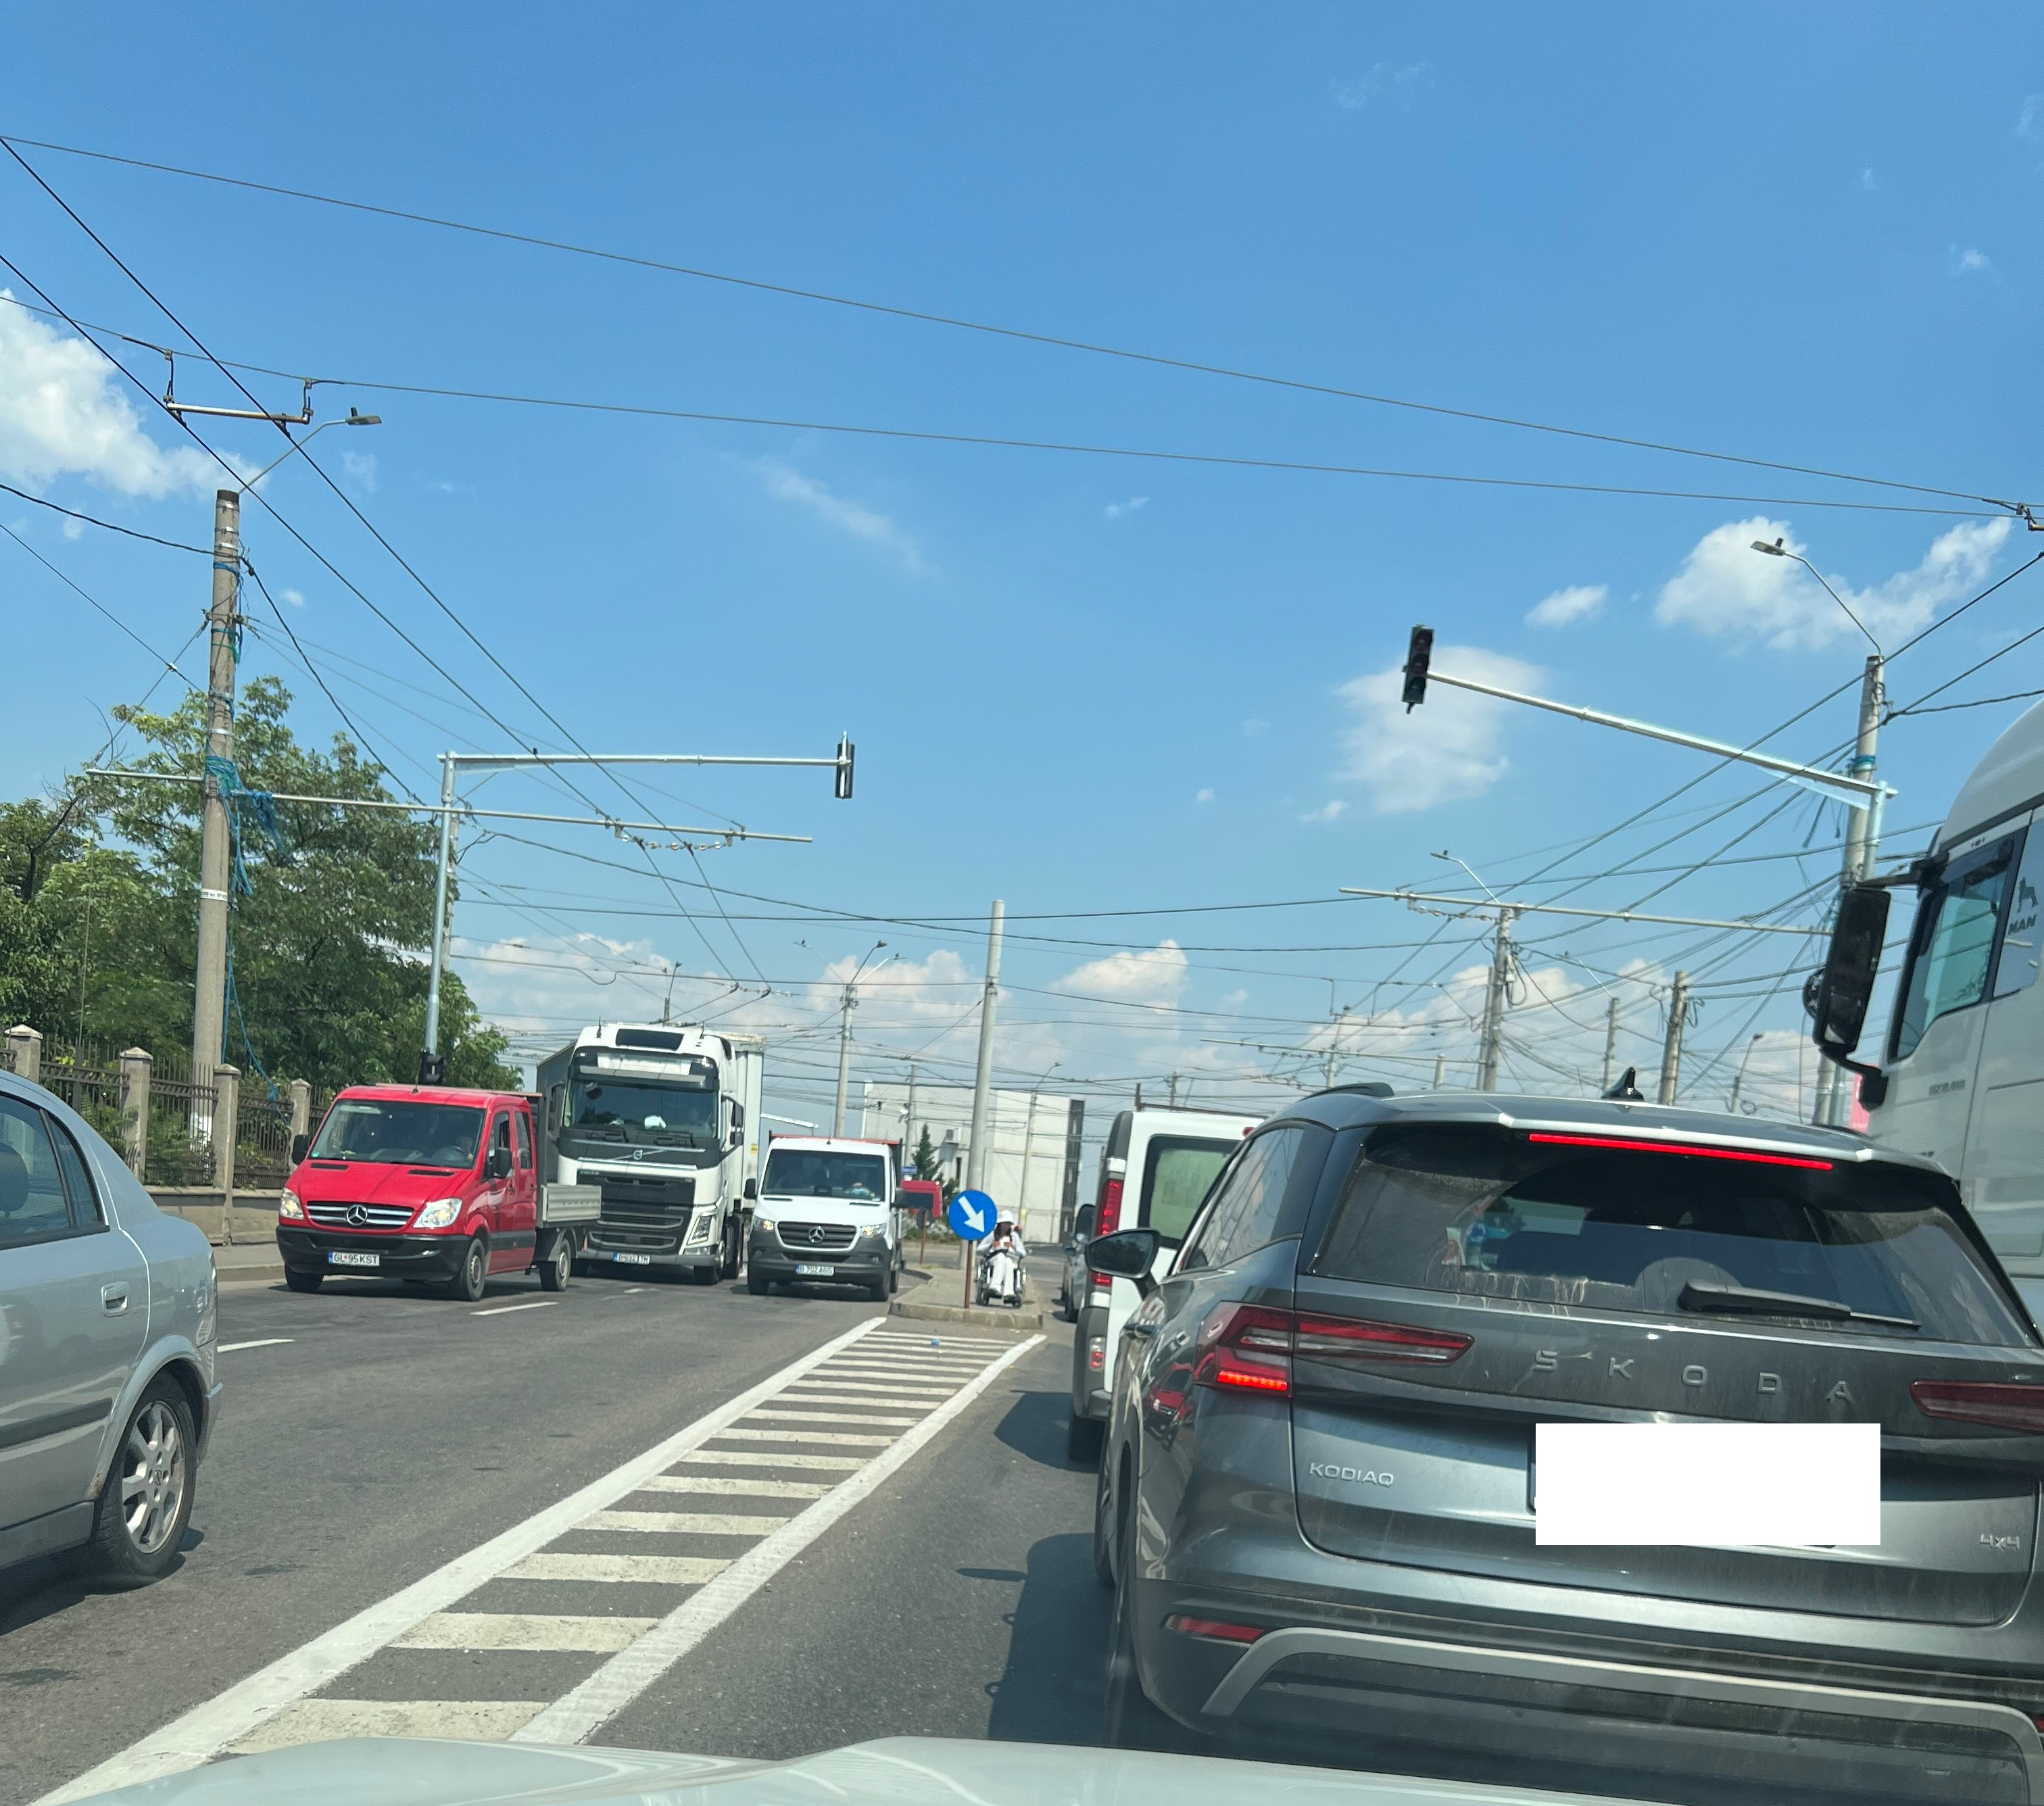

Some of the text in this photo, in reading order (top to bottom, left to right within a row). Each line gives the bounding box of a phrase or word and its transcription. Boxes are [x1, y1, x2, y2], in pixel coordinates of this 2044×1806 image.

[2008, 914, 2037, 935] MAN
[1533, 1349, 1853, 1402] SKODA
[1309, 1462, 1394, 1487] KODIAQ
